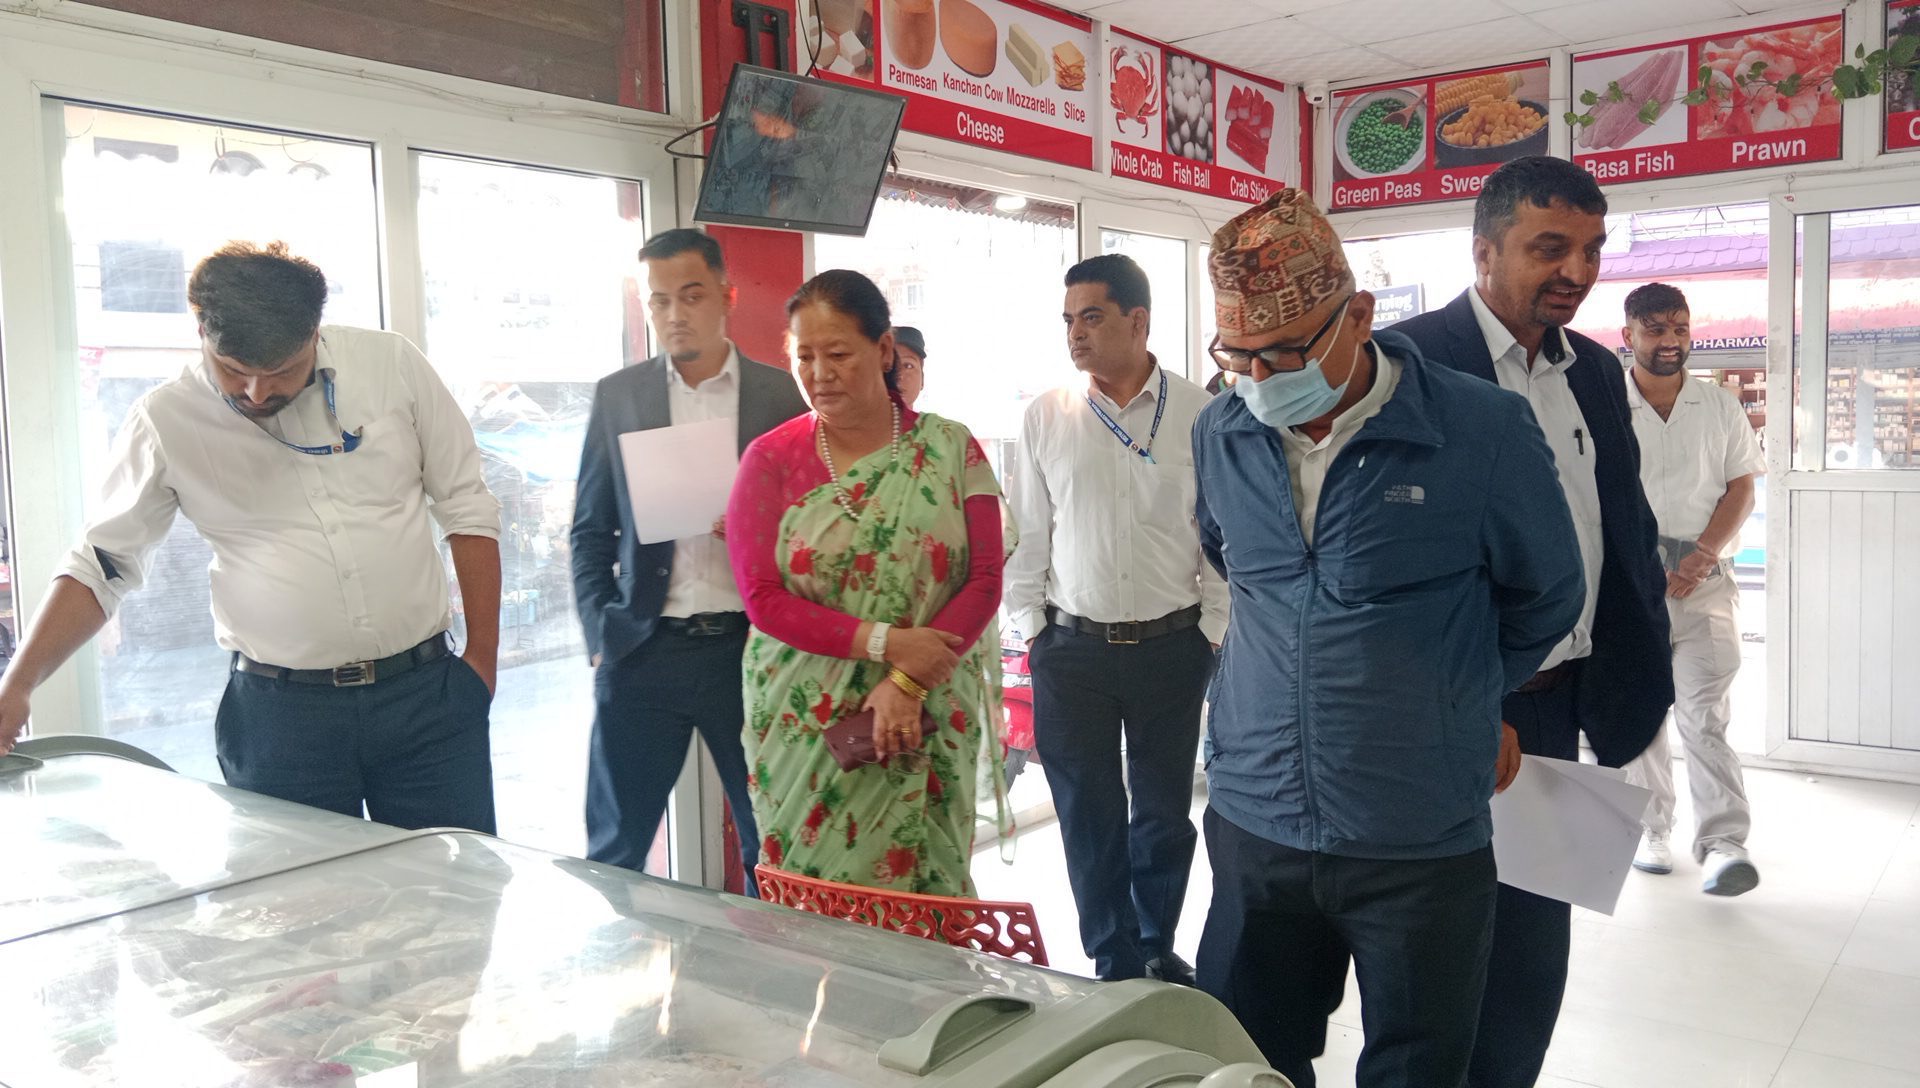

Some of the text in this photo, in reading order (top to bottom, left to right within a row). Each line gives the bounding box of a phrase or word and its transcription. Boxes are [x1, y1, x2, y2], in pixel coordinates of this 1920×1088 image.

[889, 64, 937, 91] Parmesan
[943, 72, 1004, 102] Kanchan Cow
[1006, 87, 1056, 116] Mozzarella
[1064, 101, 1086, 123] Slice
[957, 111, 1005, 144] Cheese
[1731, 138, 1806, 163] Prawn
[1140, 154, 1163, 179] Crab
[1173, 161, 1210, 189] Fish Ball
[1584, 151, 1675, 179] Basa Fish
[1230, 175, 1270, 201] Crab Stick
[1335, 181, 1422, 205] Green Peas
